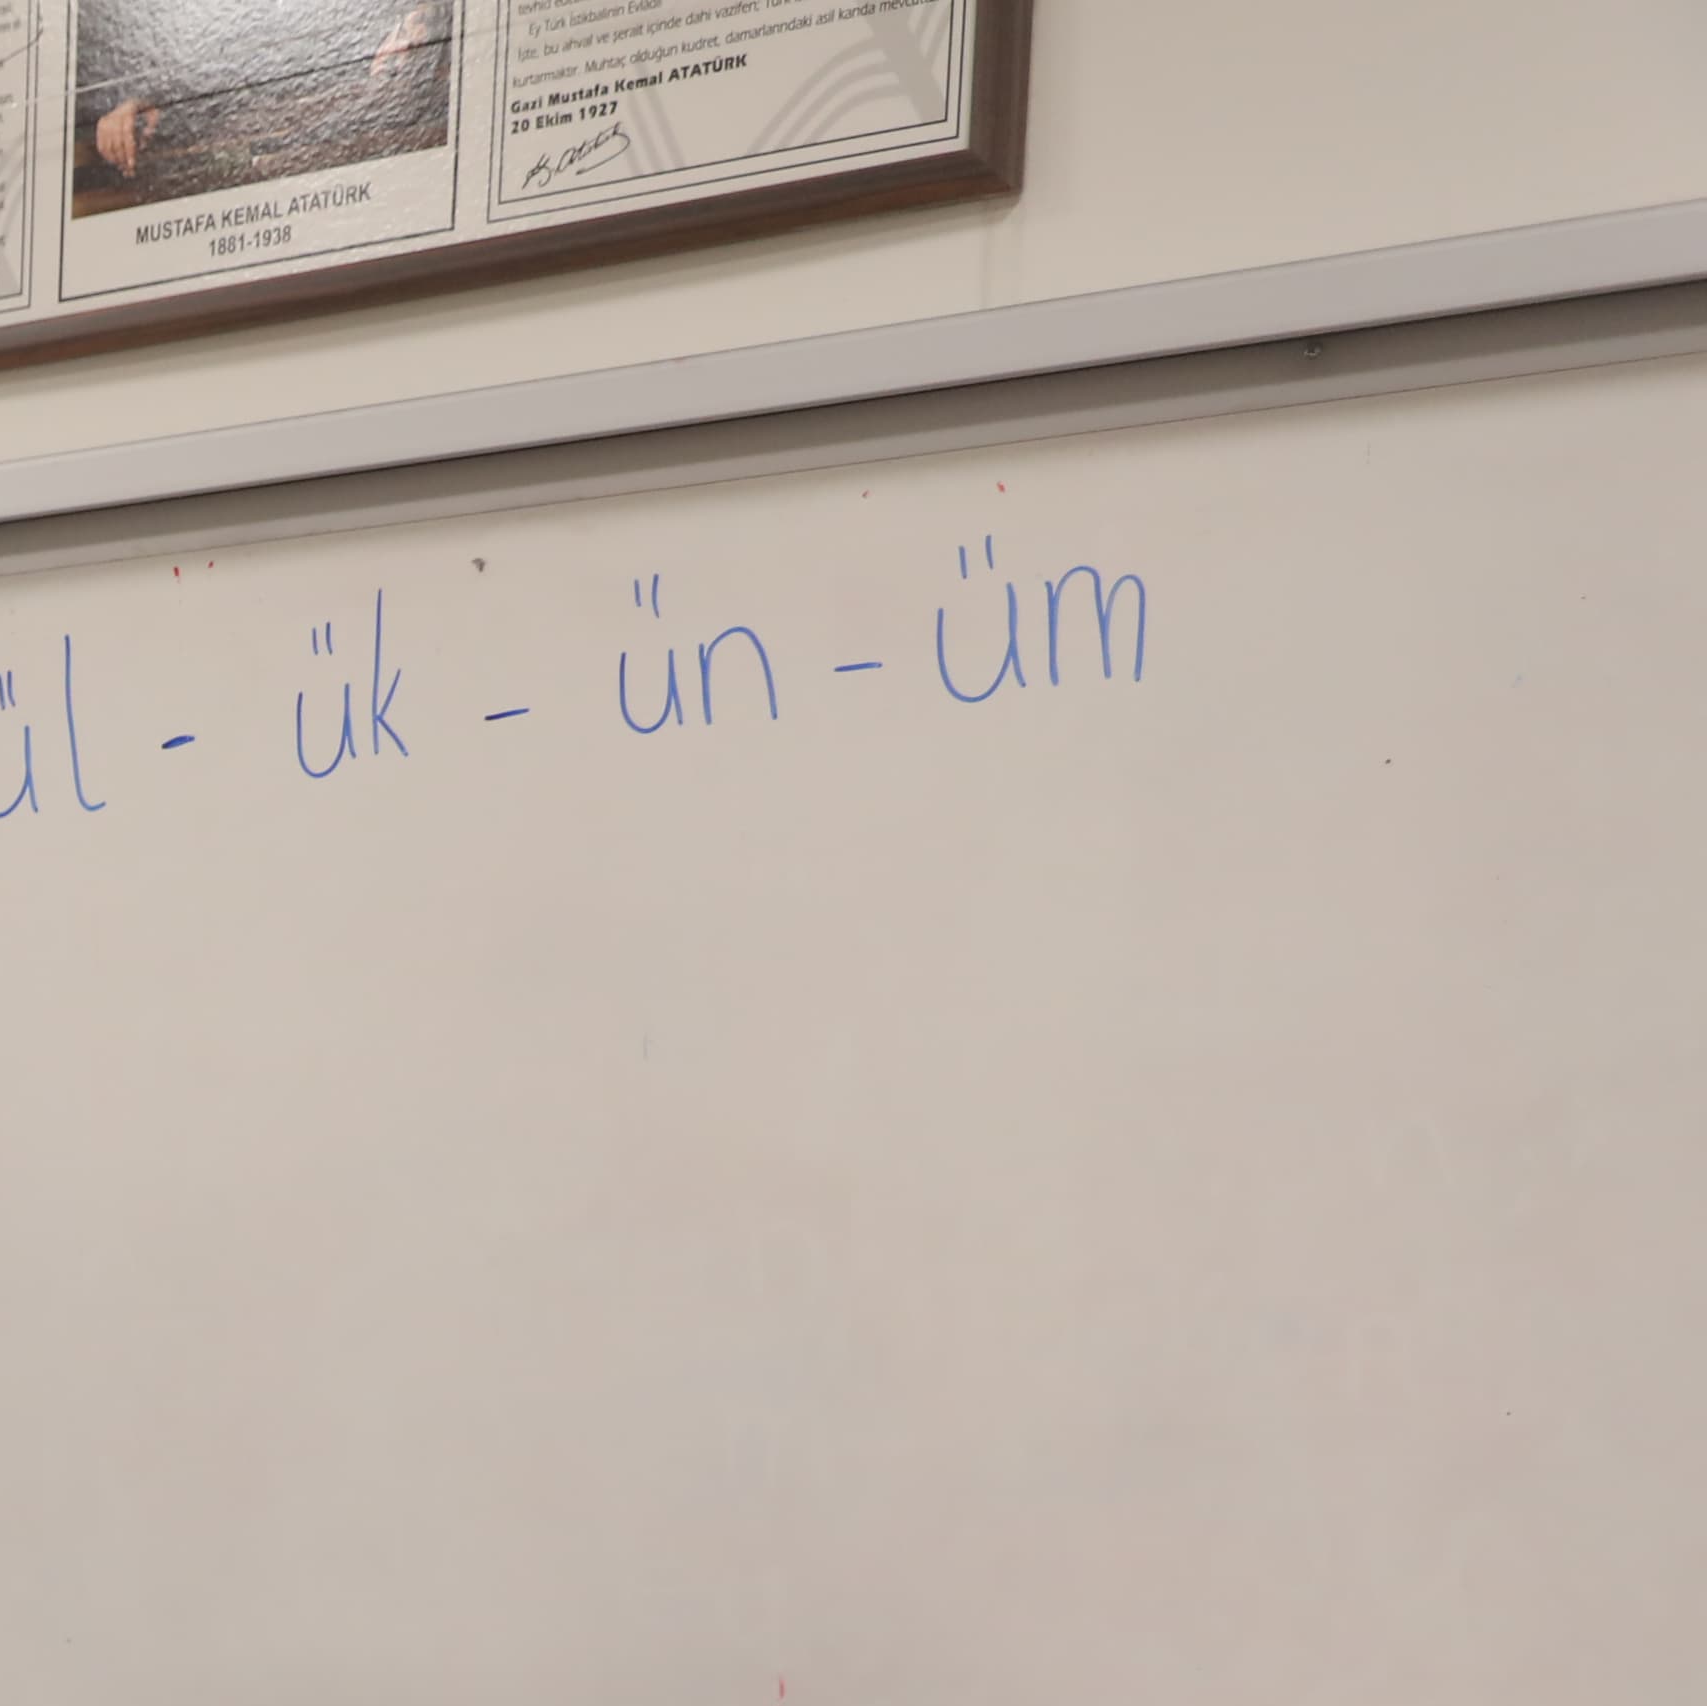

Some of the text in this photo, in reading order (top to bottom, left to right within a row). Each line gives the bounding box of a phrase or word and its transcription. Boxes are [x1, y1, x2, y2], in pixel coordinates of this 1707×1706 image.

[511, 54, 748, 114] Gazi Mustafa Kemal ATATÜRK
[510, 100, 618, 135] 20 Ekim 1927
[136, 182, 373, 246] MUSTAFA KEMAL ATATÜRK
[209, 224, 293, 258] 1881-1938
[297, 589, 408, 778] ük
[619, 574, 777, 733] ün
[937, 535, 1146, 702] üm
